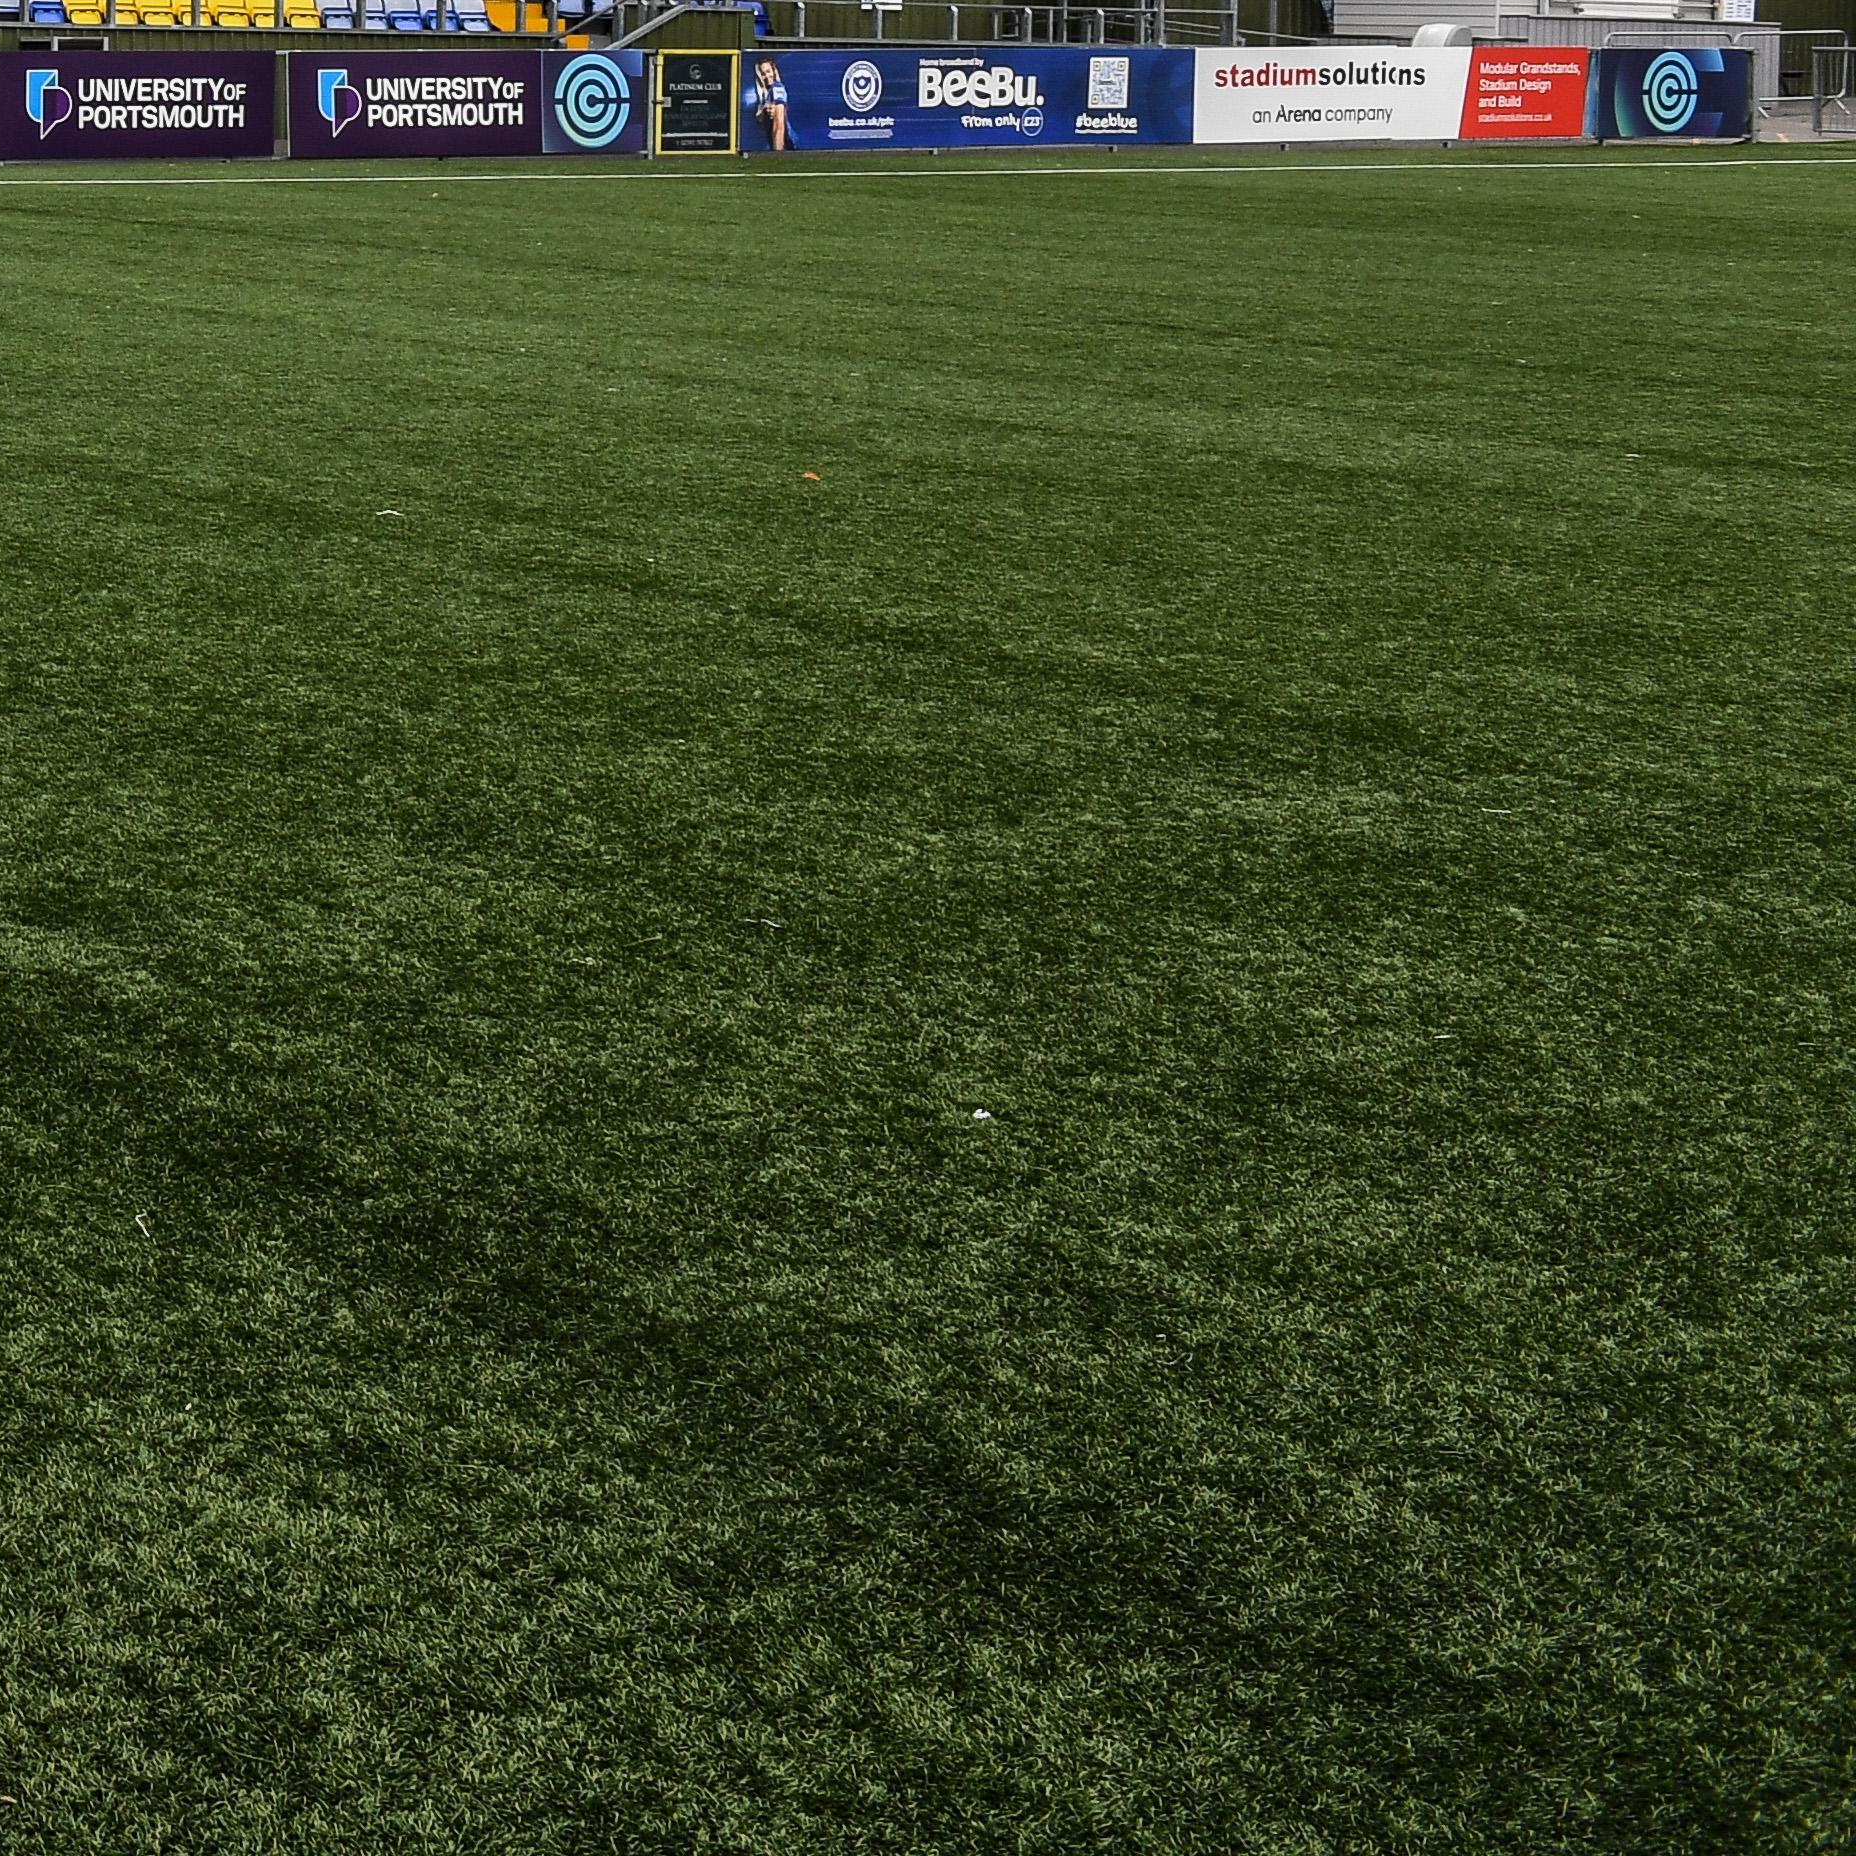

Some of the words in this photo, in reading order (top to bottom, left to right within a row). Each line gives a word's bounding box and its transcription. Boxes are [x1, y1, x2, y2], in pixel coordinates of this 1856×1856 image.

[1479, 62, 1518, 74] Modular
[1520, 62, 1581, 75] Grandstands,
[78, 78, 224, 102] UNIVERSITY
[223, 84, 246, 100] OF
[366, 77, 503, 101] UNIVERSITY
[502, 83, 525, 99] OF
[1479, 79, 1518, 91] Stadium
[1519, 78, 1552, 93] Design
[1478, 97, 1496, 107] and
[1497, 95, 1522, 108] Build
[78, 104, 245, 130] PORTSMOUTH
[367, 103, 524, 127] PORTSMOUTH
[994, 113, 1021, 131] only
[1075, 112, 1138, 129] #beeblue
[1252, 110, 1272, 124] an
[1275, 105, 1322, 122] Arena
[1325, 107, 1393, 124] company
